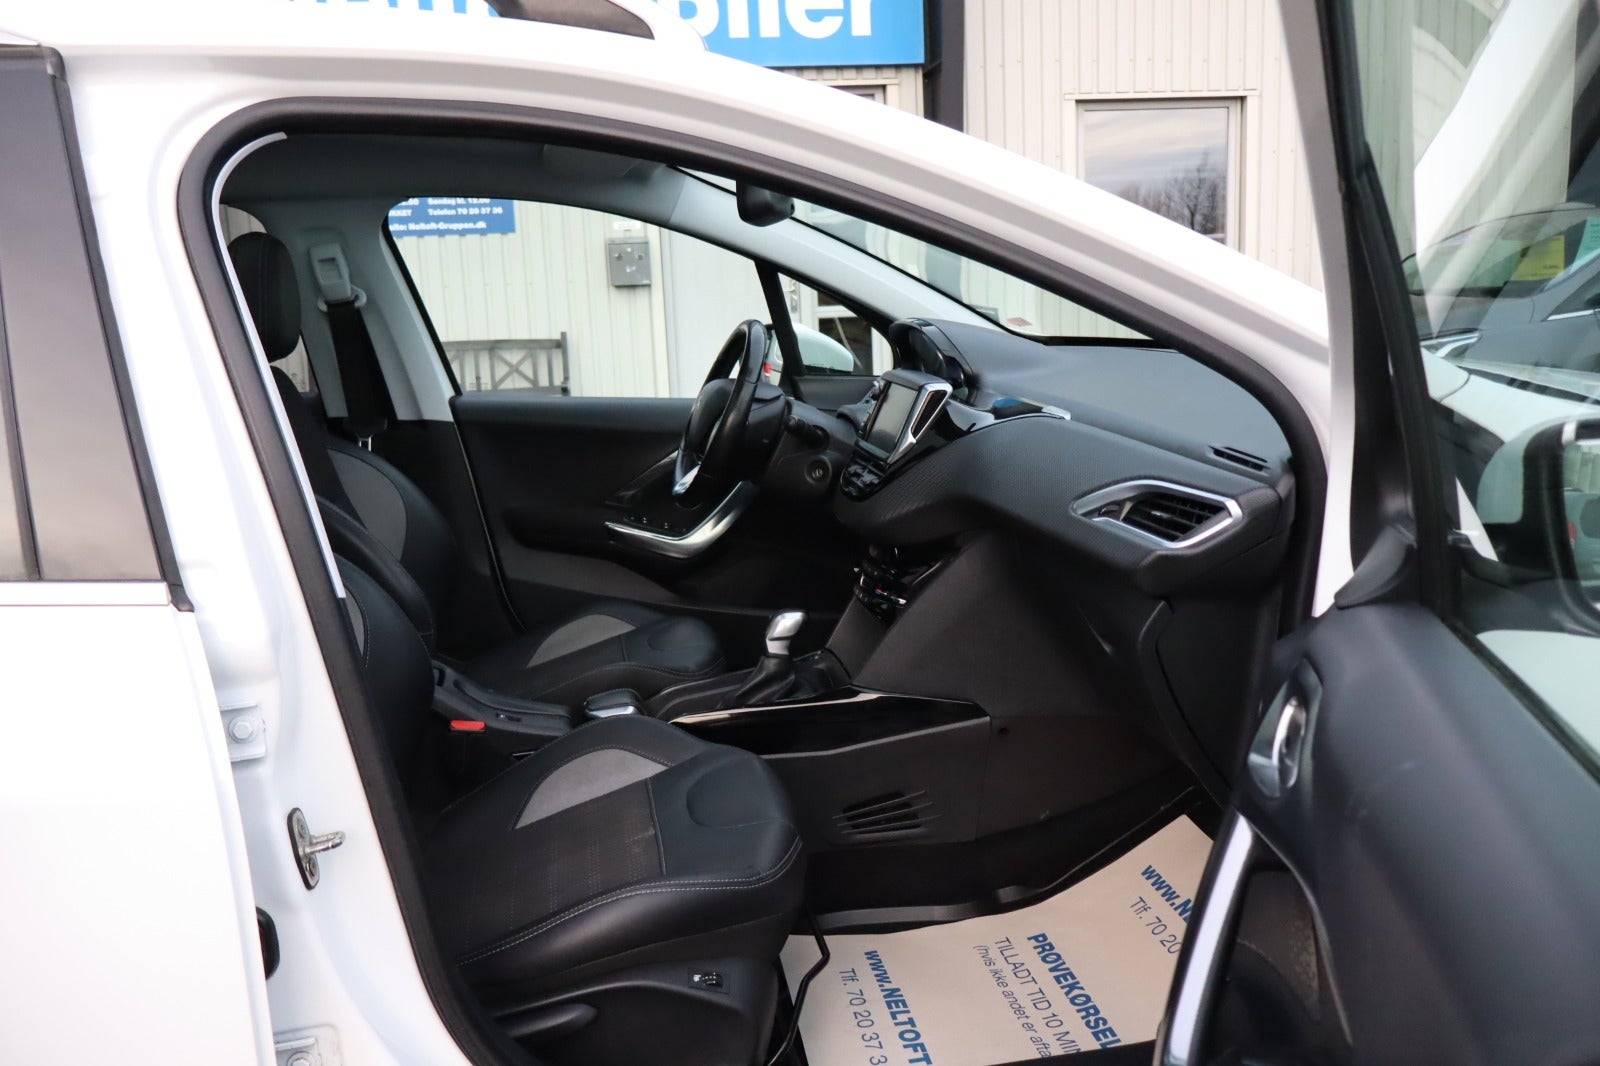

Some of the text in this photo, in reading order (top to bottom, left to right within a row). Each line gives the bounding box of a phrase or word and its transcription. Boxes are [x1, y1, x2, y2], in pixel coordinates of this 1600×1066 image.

[427, 208, 456, 216] Telefon
[457, 207, 468, 215] 70
[469, 207, 480, 215] 20
[481, 207, 491, 215] 37
[1130, 896, 1183, 954] Tlf. 70 20
[839, 968, 859, 986] Tlf.
[995, 936, 1038, 985] TILLADT
[1027, 988, 1052, 1011] TID
[1042, 1012, 1064, 1029] 10
[847, 989, 867, 1007] 70
[972, 945, 996, 968] (hvis
[989, 968, 1009, 988] ikke
[1002, 989, 1030, 1020] andet
[1022, 1021, 1038, 1034] er
[1027, 932, 1122, 1050] PRØVEKØRSEL
[853, 1010, 875, 1028] 20
[861, 1032, 883, 1050] 37
